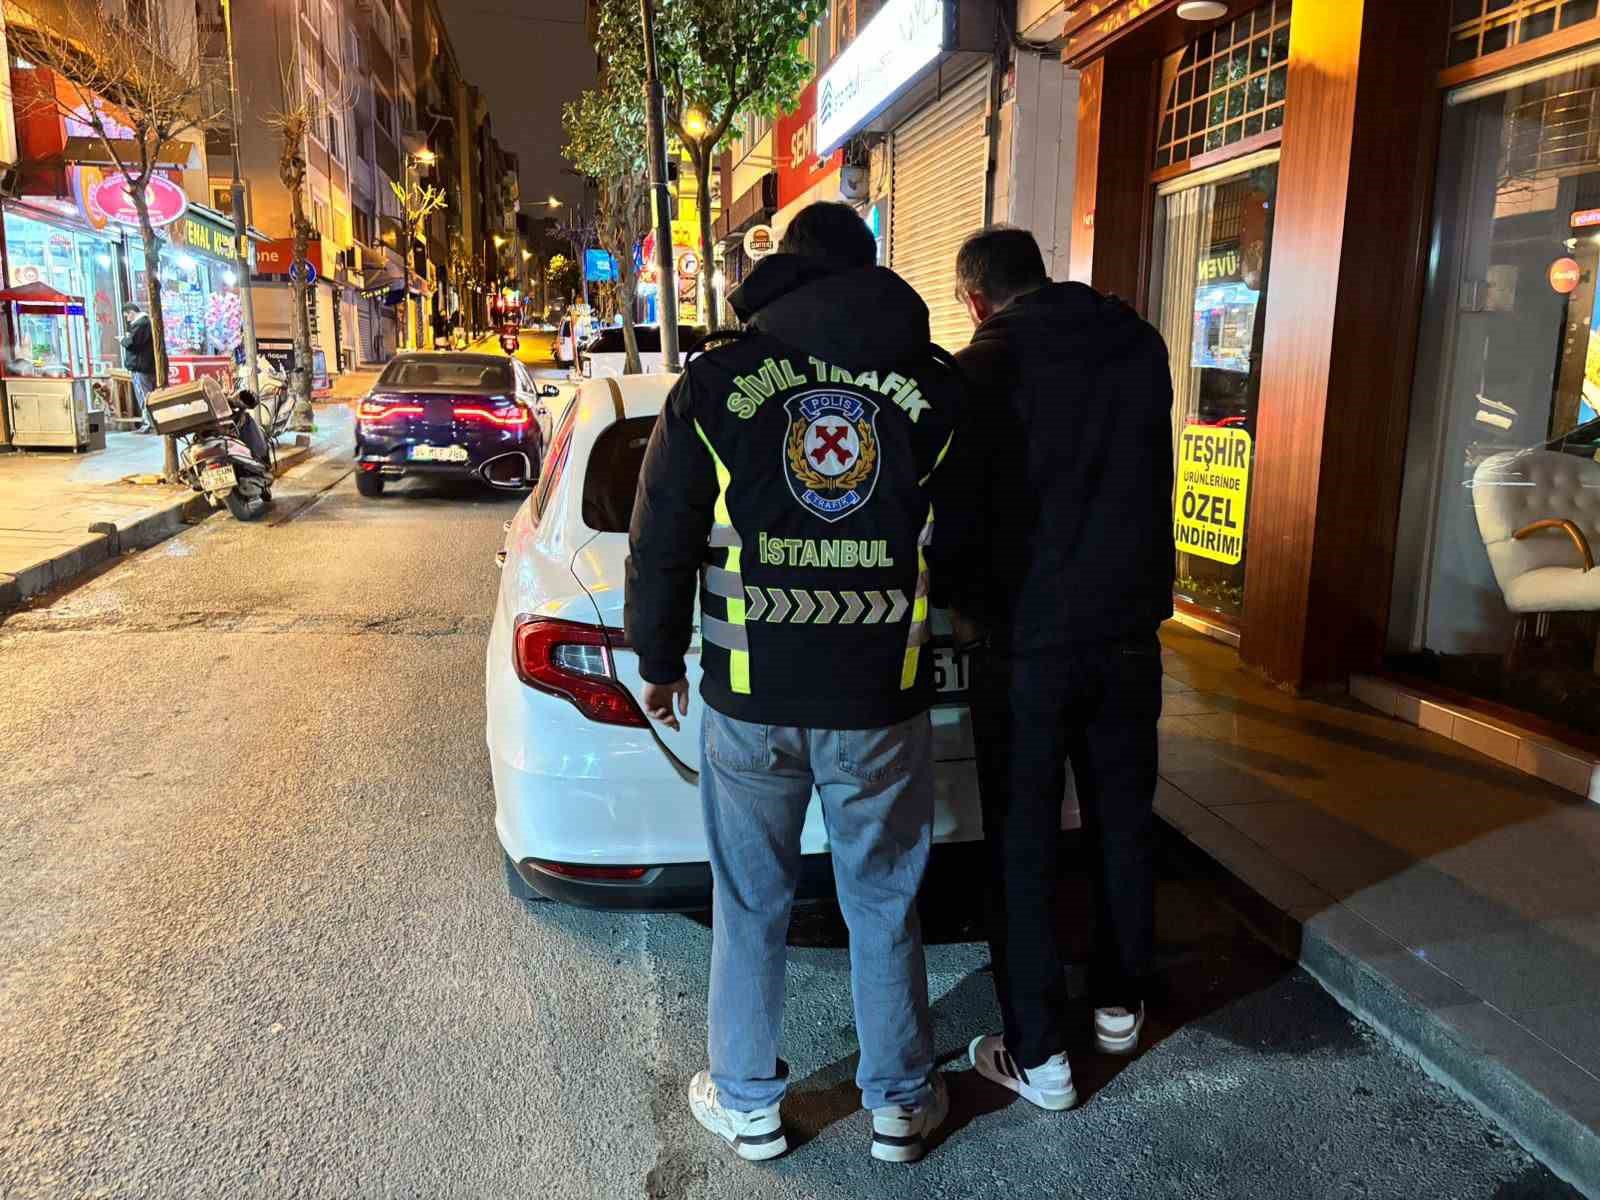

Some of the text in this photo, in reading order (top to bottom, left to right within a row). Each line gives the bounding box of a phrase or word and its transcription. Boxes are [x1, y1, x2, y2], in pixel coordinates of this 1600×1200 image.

[726, 357, 807, 420] SİVİL
[1183, 431, 1246, 471] TEŞHİR
[1182, 486, 1236, 528] ÖZEL
[759, 531, 894, 568] İSTANBUL
[1175, 519, 1240, 557] İNDİRİM!
